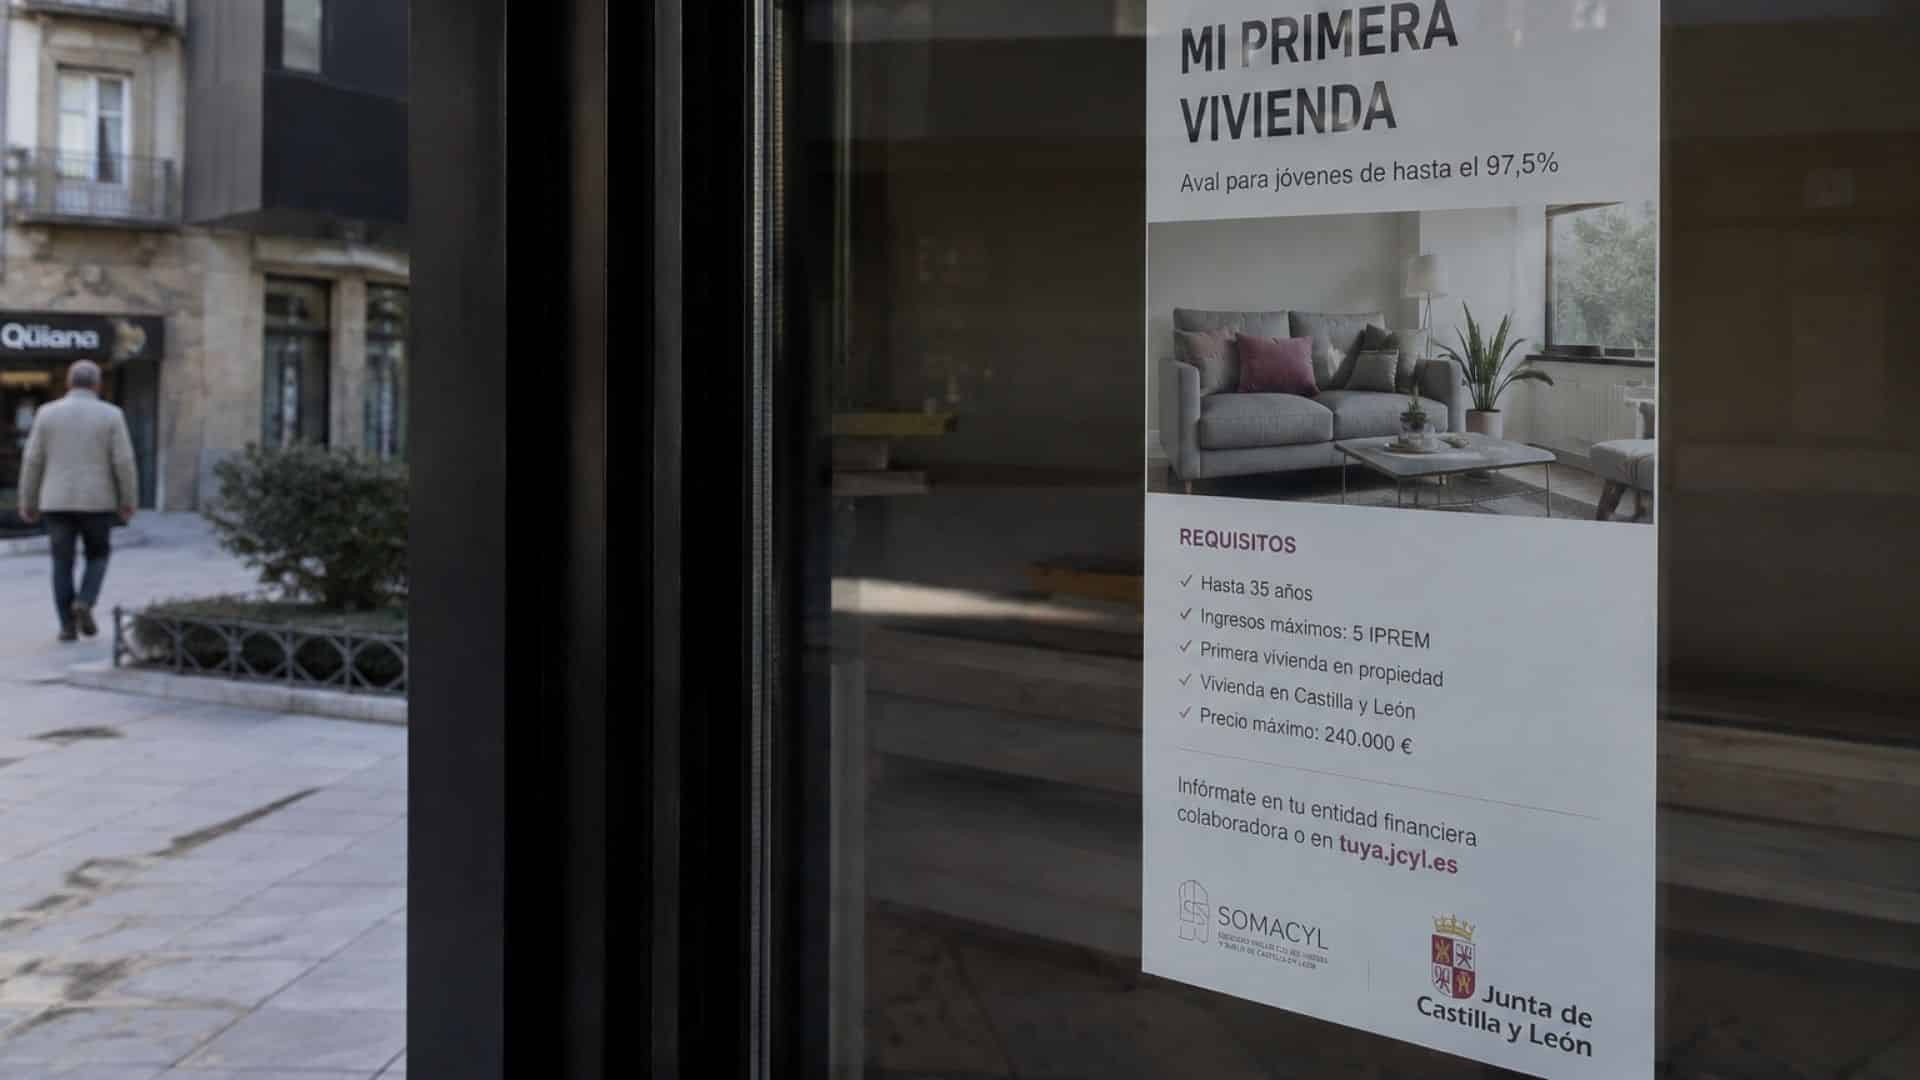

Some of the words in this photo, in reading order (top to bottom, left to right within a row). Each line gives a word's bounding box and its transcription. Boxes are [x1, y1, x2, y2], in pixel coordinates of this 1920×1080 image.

[1181, 23, 1226, 74] MI
[1241, 0, 1458, 67] PRIMERA
[1180, 80, 1397, 143] VIVIENDA
[1181, 172, 1220, 193] Aval
[1226, 174, 1269, 195] para
[1274, 164, 1353, 192] jóvenes
[1360, 162, 1386, 182] de
[1393, 158, 1452, 181] hasta
[1459, 157, 1478, 177] el
[1486, 152, 1559, 179] 97,5%
[1179, 528, 1297, 553] REQUISITOS
[1201, 575, 1245, 596] Hasta
[1250, 579, 1270, 598] 35
[1274, 583, 1313, 601] años
[1201, 607, 1265, 633] Ingresos
[1270, 616, 1347, 640] máximos:
[1353, 625, 1364, 642] 5
[1369, 627, 1431, 649] IPREM
[1200, 641, 1258, 664] Primera
[1263, 648, 1328, 673] vivienda
[1333, 659, 1353, 676] en
[1359, 662, 1444, 688] propiedad
[1200, 674, 1265, 699] Vivienda
[1270, 685, 1289, 701] en
[1295, 686, 1353, 711] Castilla
[1359, 698, 1368, 716] y
[1374, 700, 1416, 721] León
[1200, 707, 1248, 730] Precio
[1252, 716, 1320, 741] máximo:
[1325, 726, 1395, 752] 240.000
[1400, 737, 1413, 755] €
[1178, 776, 1257, 806] Infórmate
[1262, 794, 1283, 812] en
[1288, 796, 1306, 815] tu
[1311, 800, 1378, 829] entidad
[1383, 812, 1478, 848] financiera
[1177, 806, 1288, 842] colaboradora
[1294, 829, 1305, 844] o
[1310, 832, 1333, 849] en
[1339, 834, 1458, 874] tuya.jcyl.es
[1218, 905, 1329, 950] SOMACYL
[1417, 996, 1501, 1035] Castilla
[1506, 1020, 1523, 1043] y
[1529, 1023, 1593, 1058] León
[1482, 985, 1553, 1020] Junta
[1560, 1003, 1593, 1029] de
